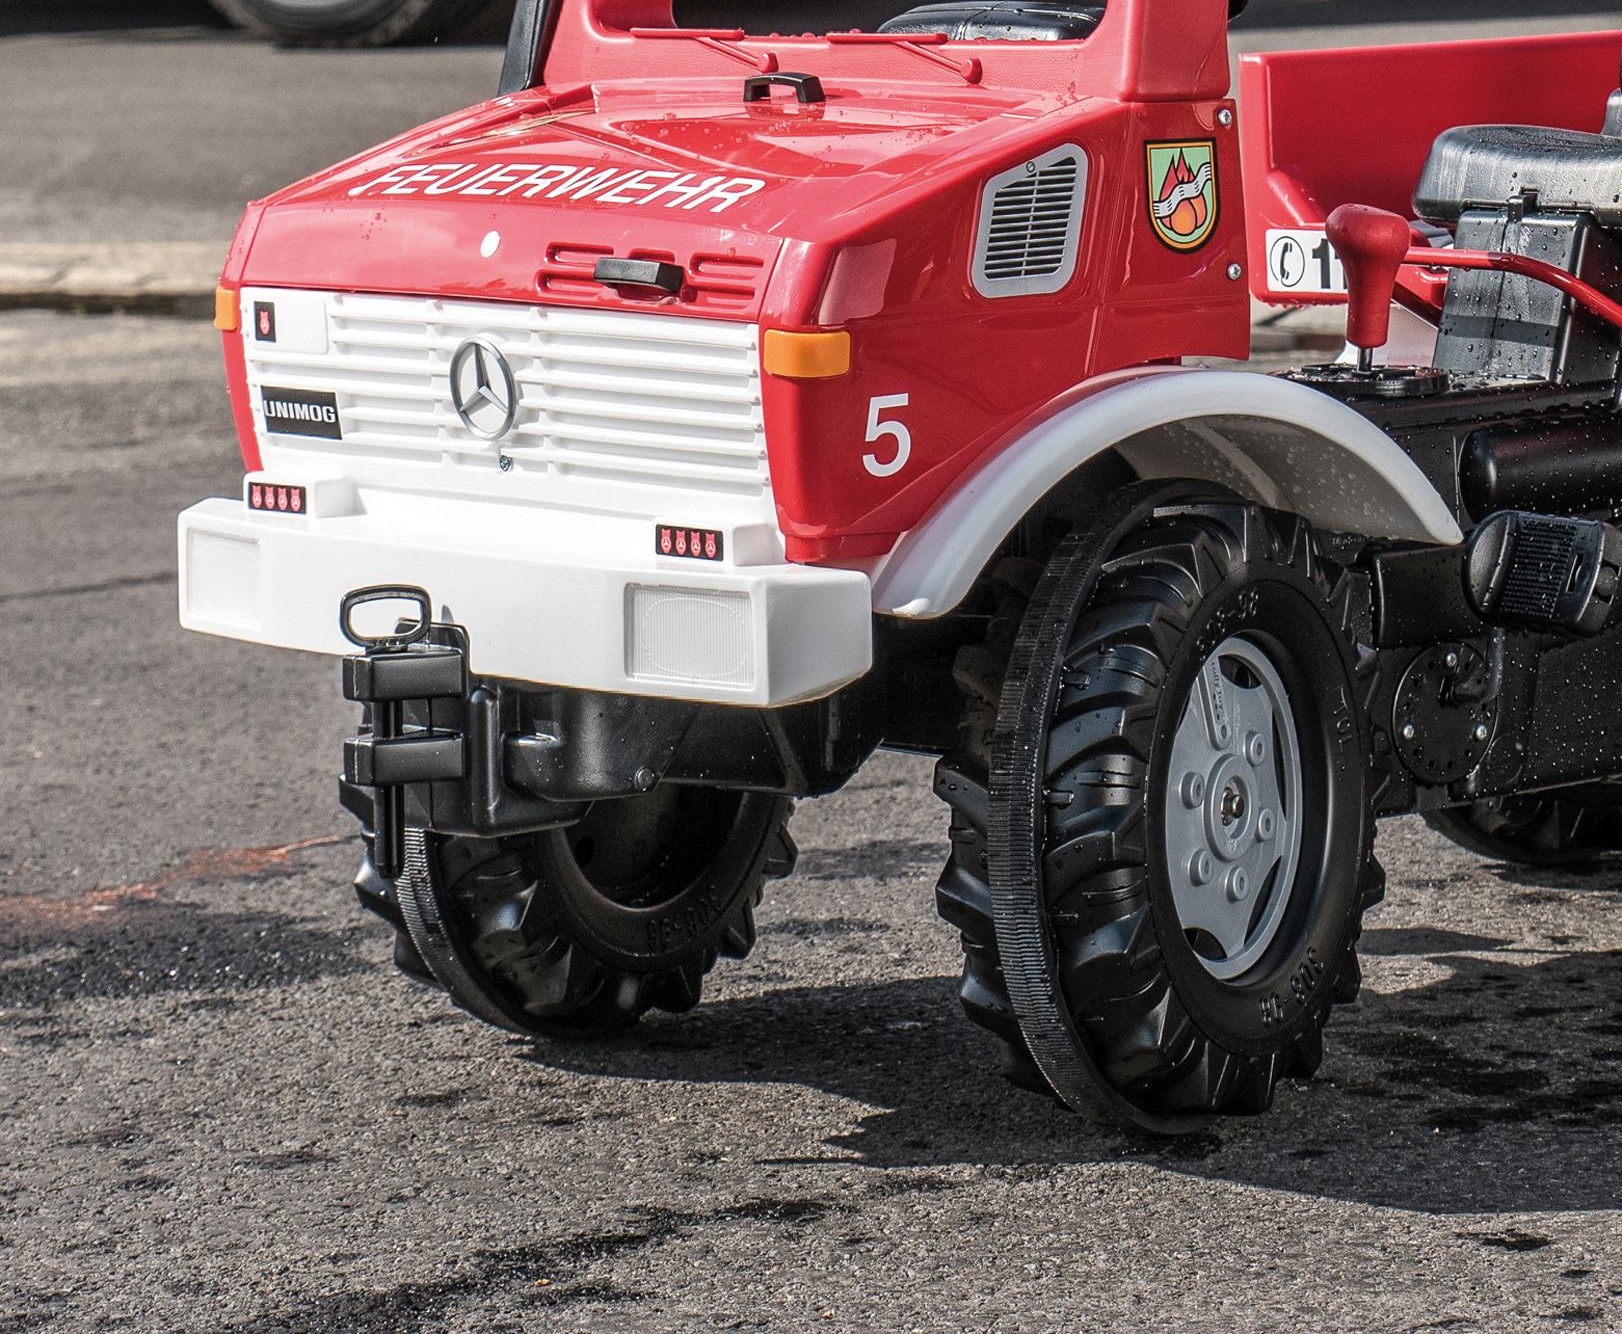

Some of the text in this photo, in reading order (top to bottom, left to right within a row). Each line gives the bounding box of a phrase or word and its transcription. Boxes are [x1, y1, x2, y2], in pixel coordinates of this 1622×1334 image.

[348, 163, 766, 213] FEUERWEHR
[263, 400, 336, 423] UNIMOG
[862, 393, 911, 477] 5
